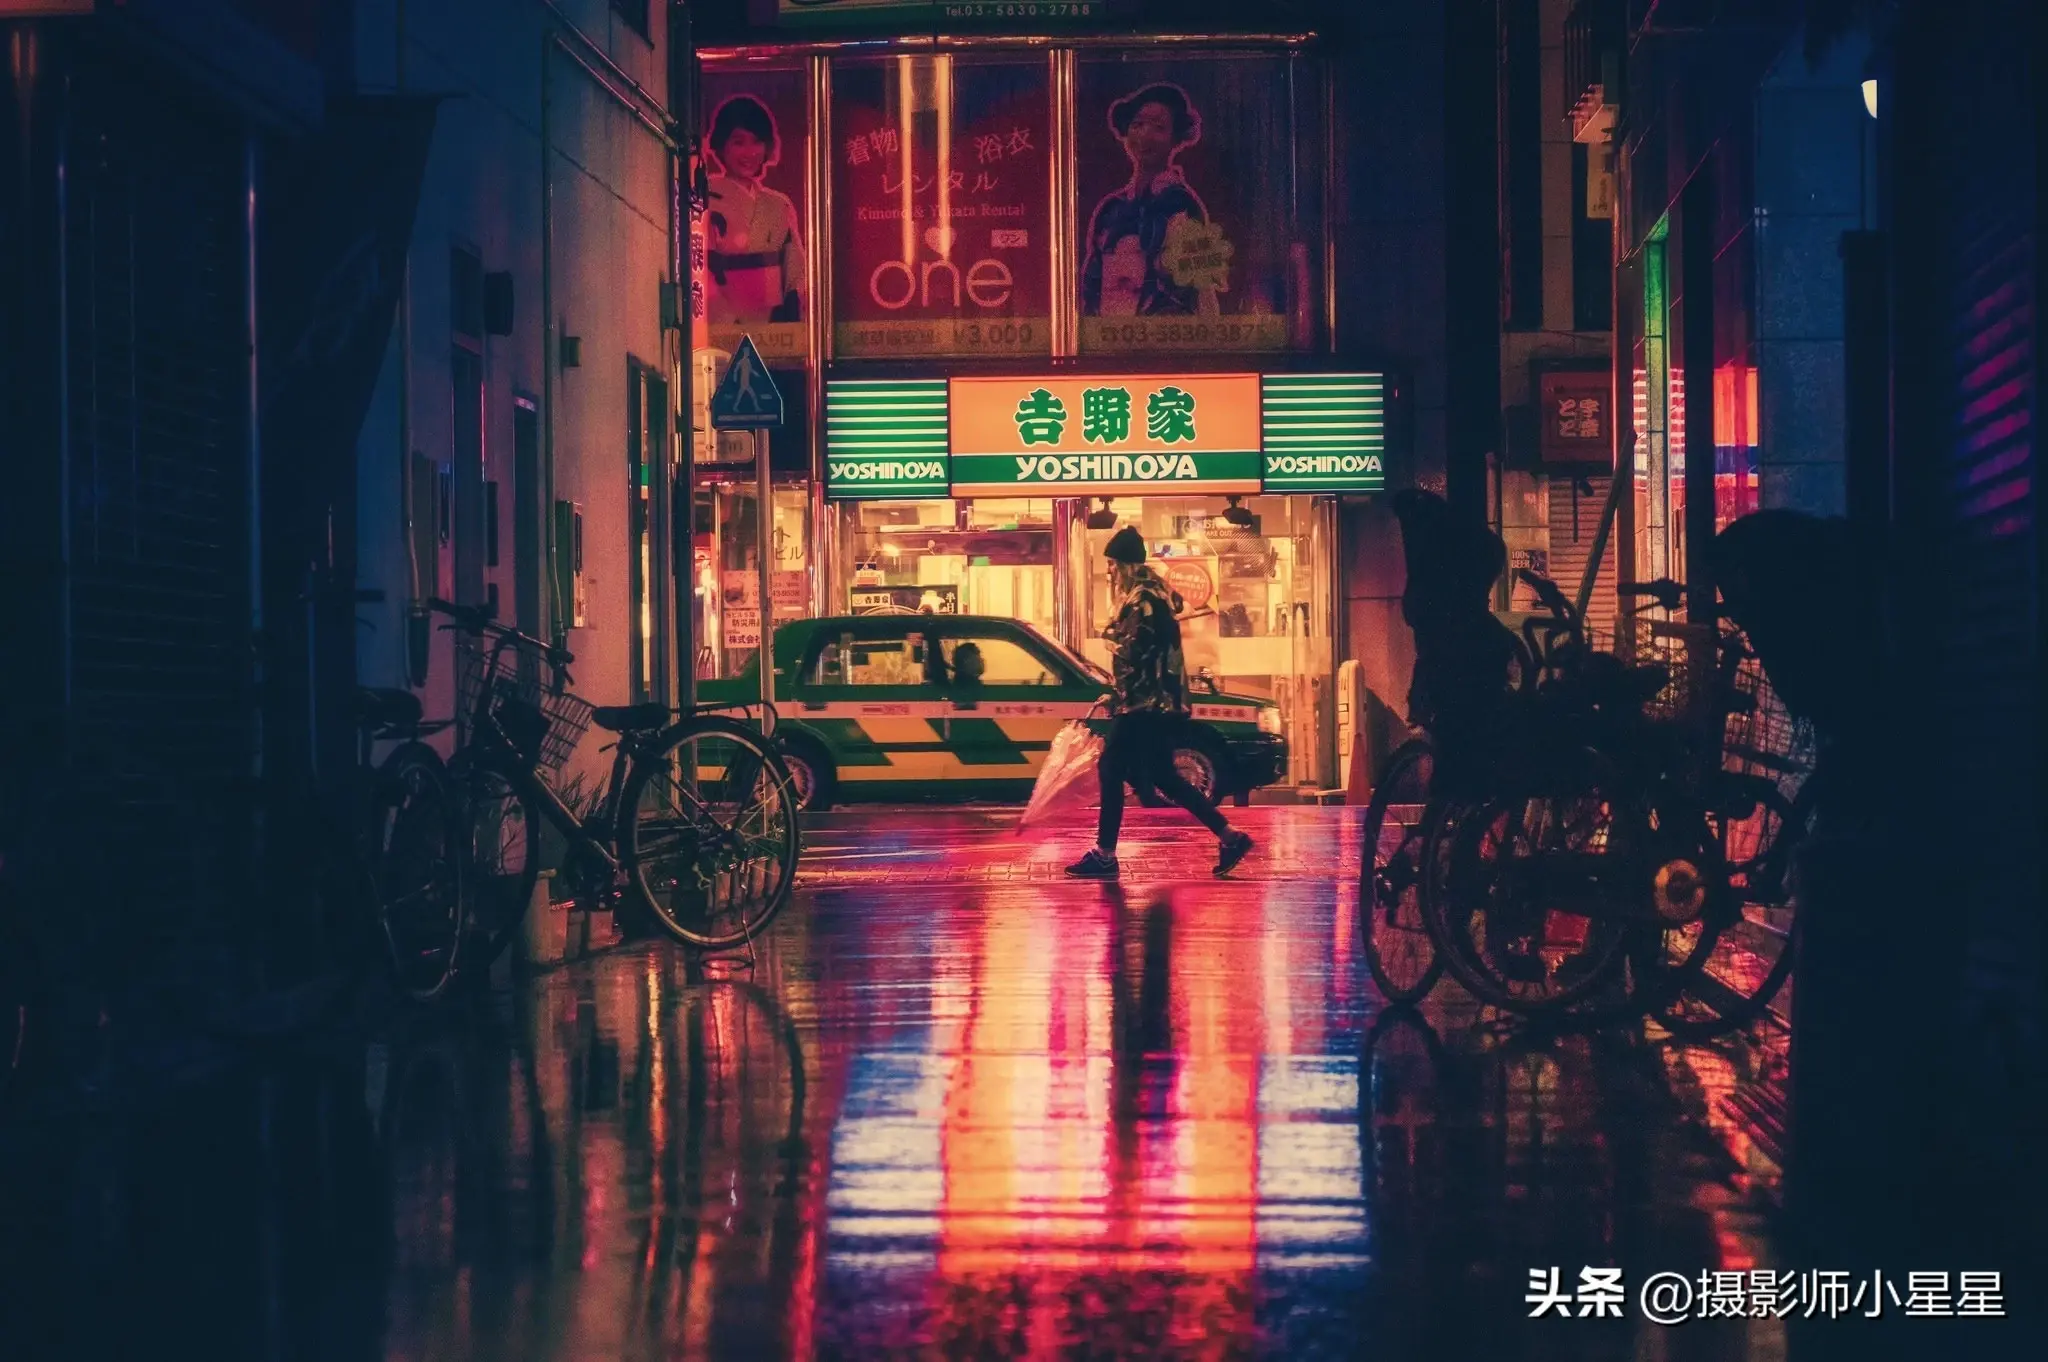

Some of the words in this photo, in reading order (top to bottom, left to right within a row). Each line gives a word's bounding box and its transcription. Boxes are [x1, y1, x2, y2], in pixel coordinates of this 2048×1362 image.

[847, 128, 900, 165] 着物
[974, 127, 1034, 164] 浴衣
[881, 171, 999, 194] レンタル
[981, 203, 1024, 216] Rental
[870, 259, 1013, 309] one
[1013, 386, 1197, 446] 吉野家
[830, 461, 945, 480] YOSHINOYA
[1016, 455, 1198, 482] YOSHINOYA
[1267, 455, 1382, 474] YOSHINOYA
